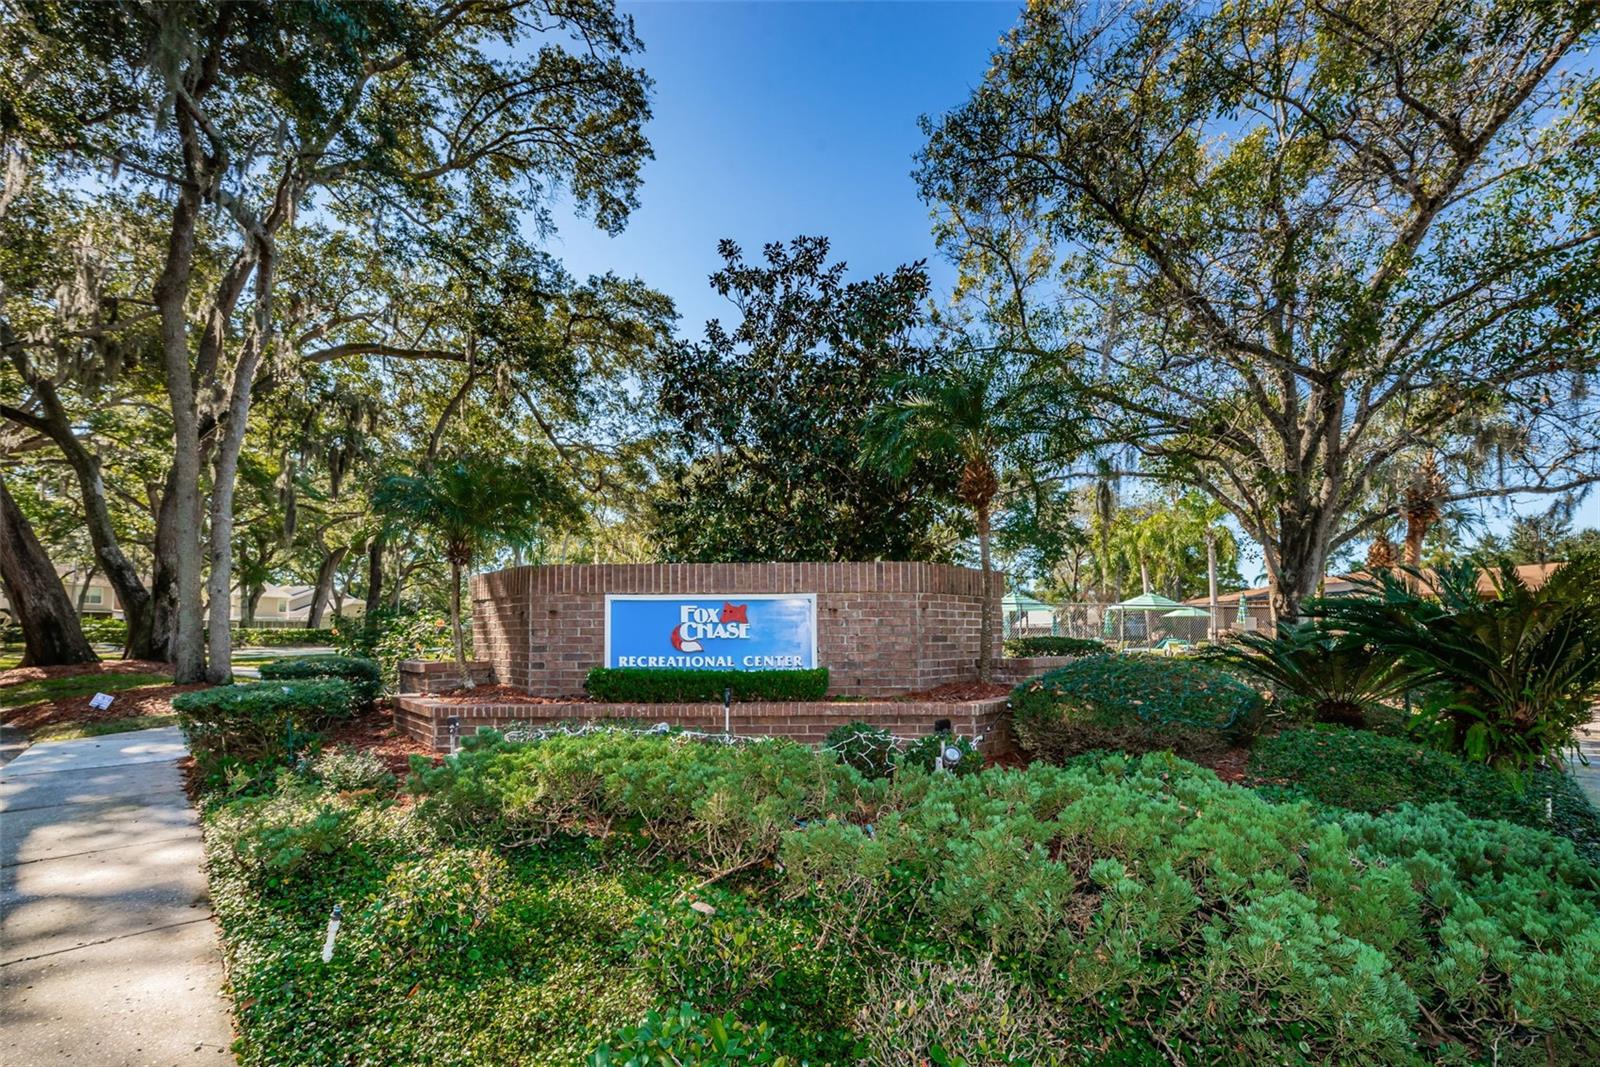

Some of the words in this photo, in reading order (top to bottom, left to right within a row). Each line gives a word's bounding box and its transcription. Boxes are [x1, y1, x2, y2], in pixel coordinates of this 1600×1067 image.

[679, 621, 751, 641] CHASE
[618, 655, 735, 668] RECREATIONAL
[743, 655, 803, 668] CENTER
